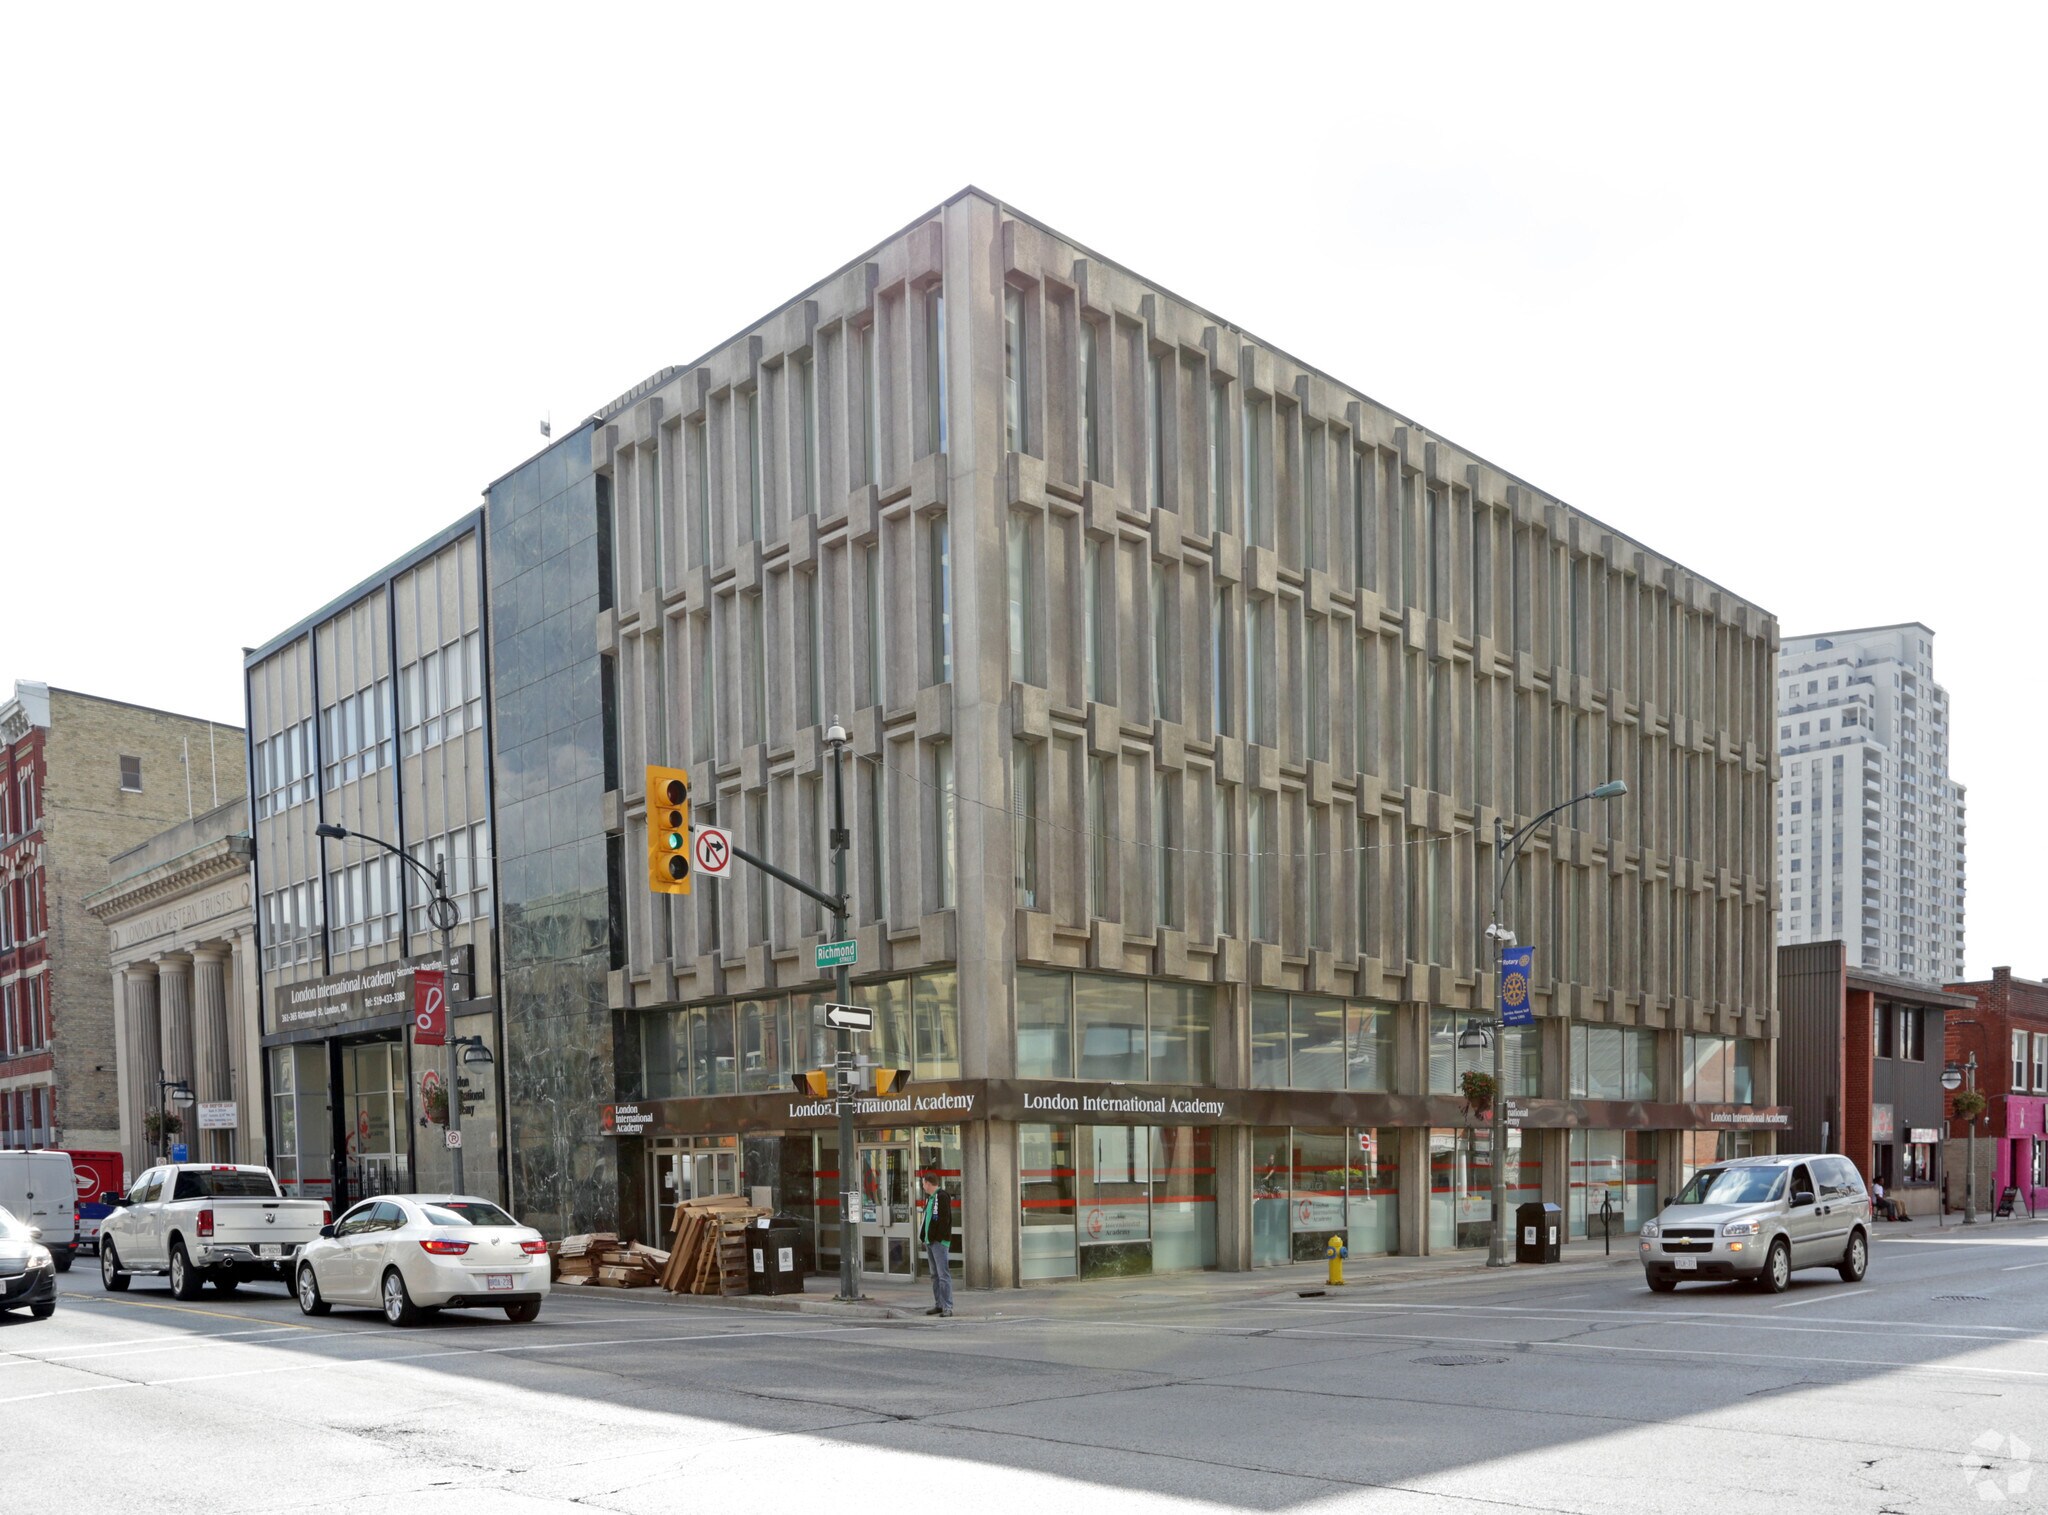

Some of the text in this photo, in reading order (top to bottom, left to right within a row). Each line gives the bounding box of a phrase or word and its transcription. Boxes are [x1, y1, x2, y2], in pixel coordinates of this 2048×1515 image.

[125, 919, 153, 943] LONDON
[162, 903, 198, 931] WESTERN
[200, 891, 233, 918] TRUSTS
[818, 942, 855, 960] Richmond
[839, 955, 855, 963] STREET
[291, 970, 396, 1004] London International Academy
[297, 1008, 316, 1020] Richmond
[340, 1003, 348, 1012] ON
[457, 1076, 469, 1087] don
[615, 1104, 638, 1114] London
[789, 1092, 975, 1118] London Iernational Academy
[1024, 1093, 1224, 1117] London International Academy
[615, 1112, 653, 1123] International
[1711, 1112, 1788, 1125] London International Academy
[616, 1123, 643, 1134] Academy
